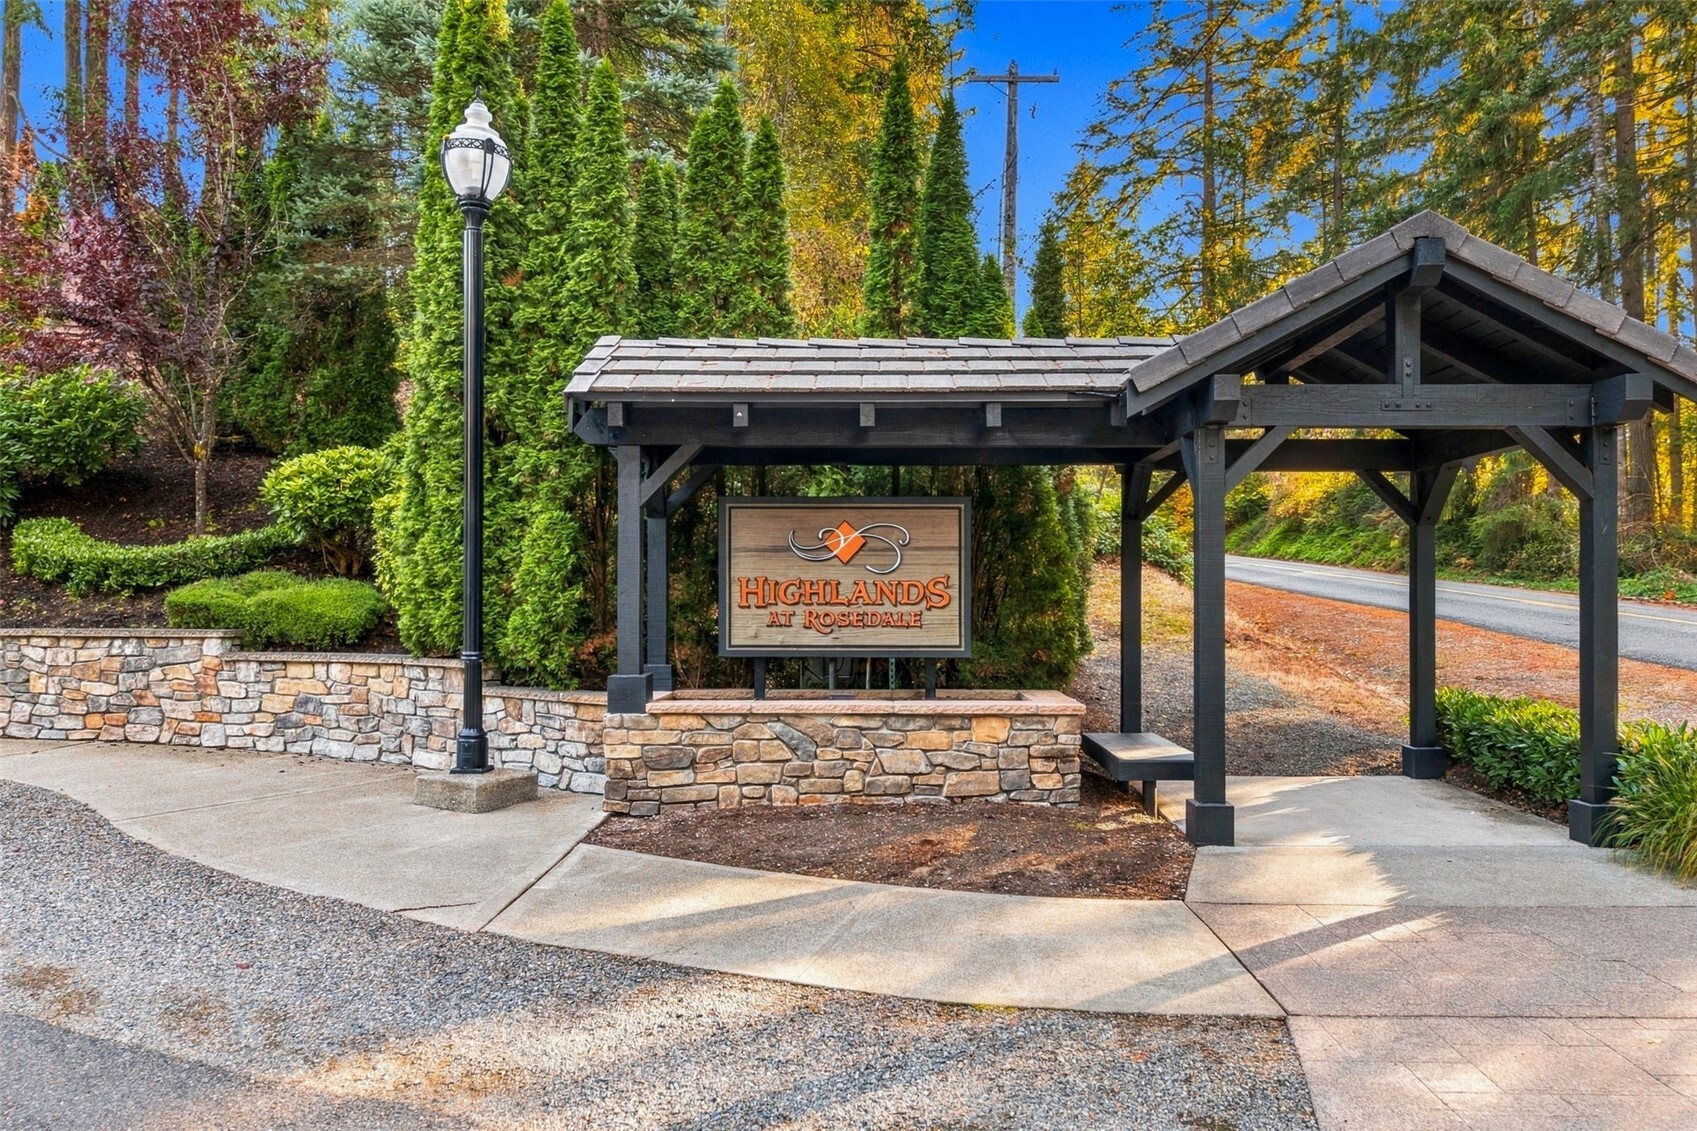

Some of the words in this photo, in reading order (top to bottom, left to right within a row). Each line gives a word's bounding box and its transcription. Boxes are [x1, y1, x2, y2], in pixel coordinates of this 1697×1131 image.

[738, 574, 951, 610] HIGHLANDS
[767, 610, 795, 627] AT
[803, 608, 922, 635] ROSEDALE
